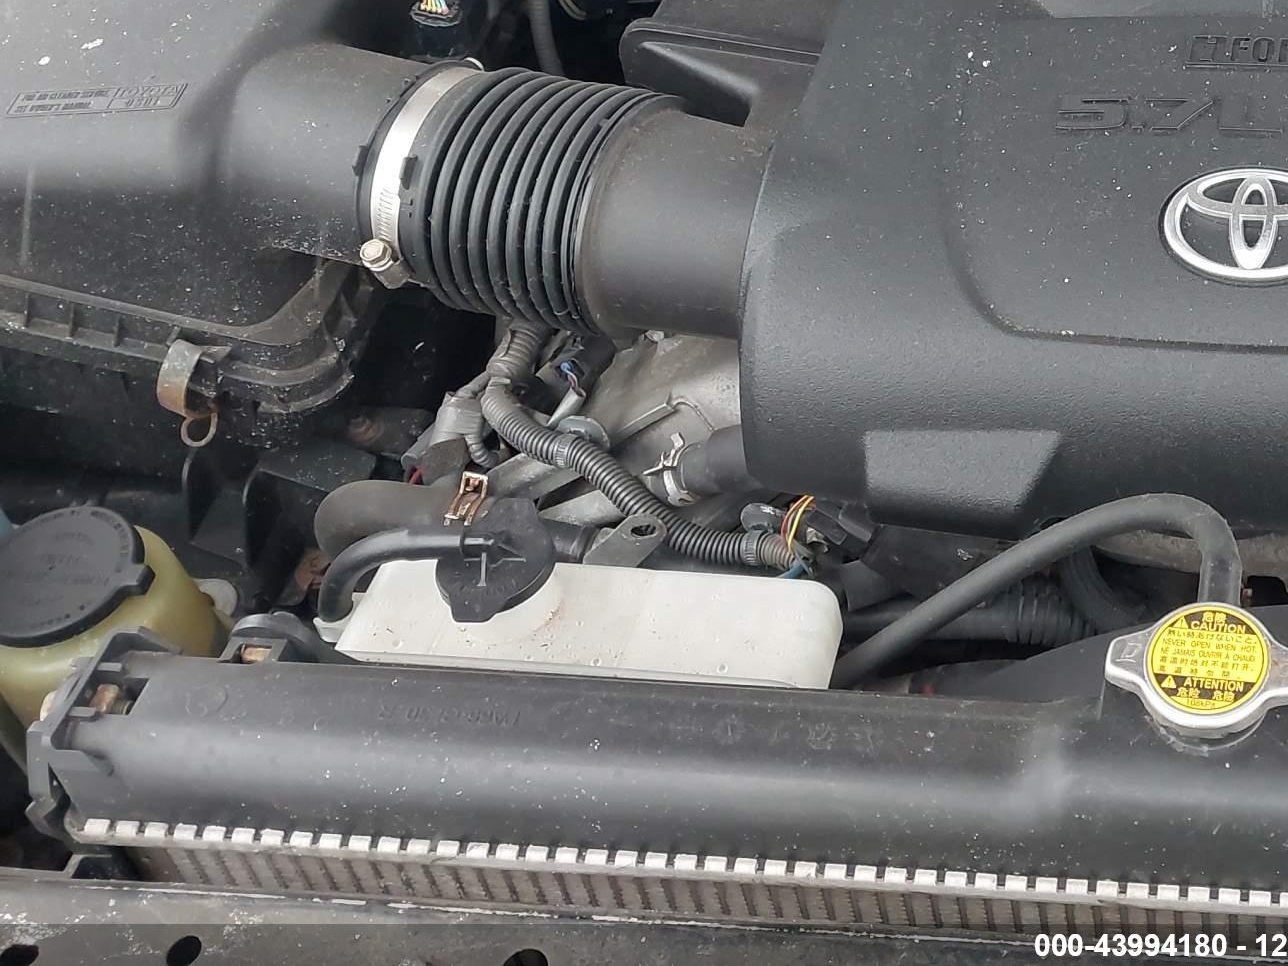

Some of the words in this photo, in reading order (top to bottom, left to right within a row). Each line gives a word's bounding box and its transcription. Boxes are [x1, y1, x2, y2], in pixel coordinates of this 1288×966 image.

[1054, 95, 1284, 136] 5.7L
[1191, 620, 1246, 634] CAUTION
[1163, 638, 1186, 647] NEVER
[1191, 640, 1210, 649] OPEN
[1216, 643, 1236, 652] WHEN
[1173, 648, 1195, 657] JAMAIS
[1199, 650, 1222, 659] OUVRIR
[1184, 676, 1244, 692] ATTENTION
